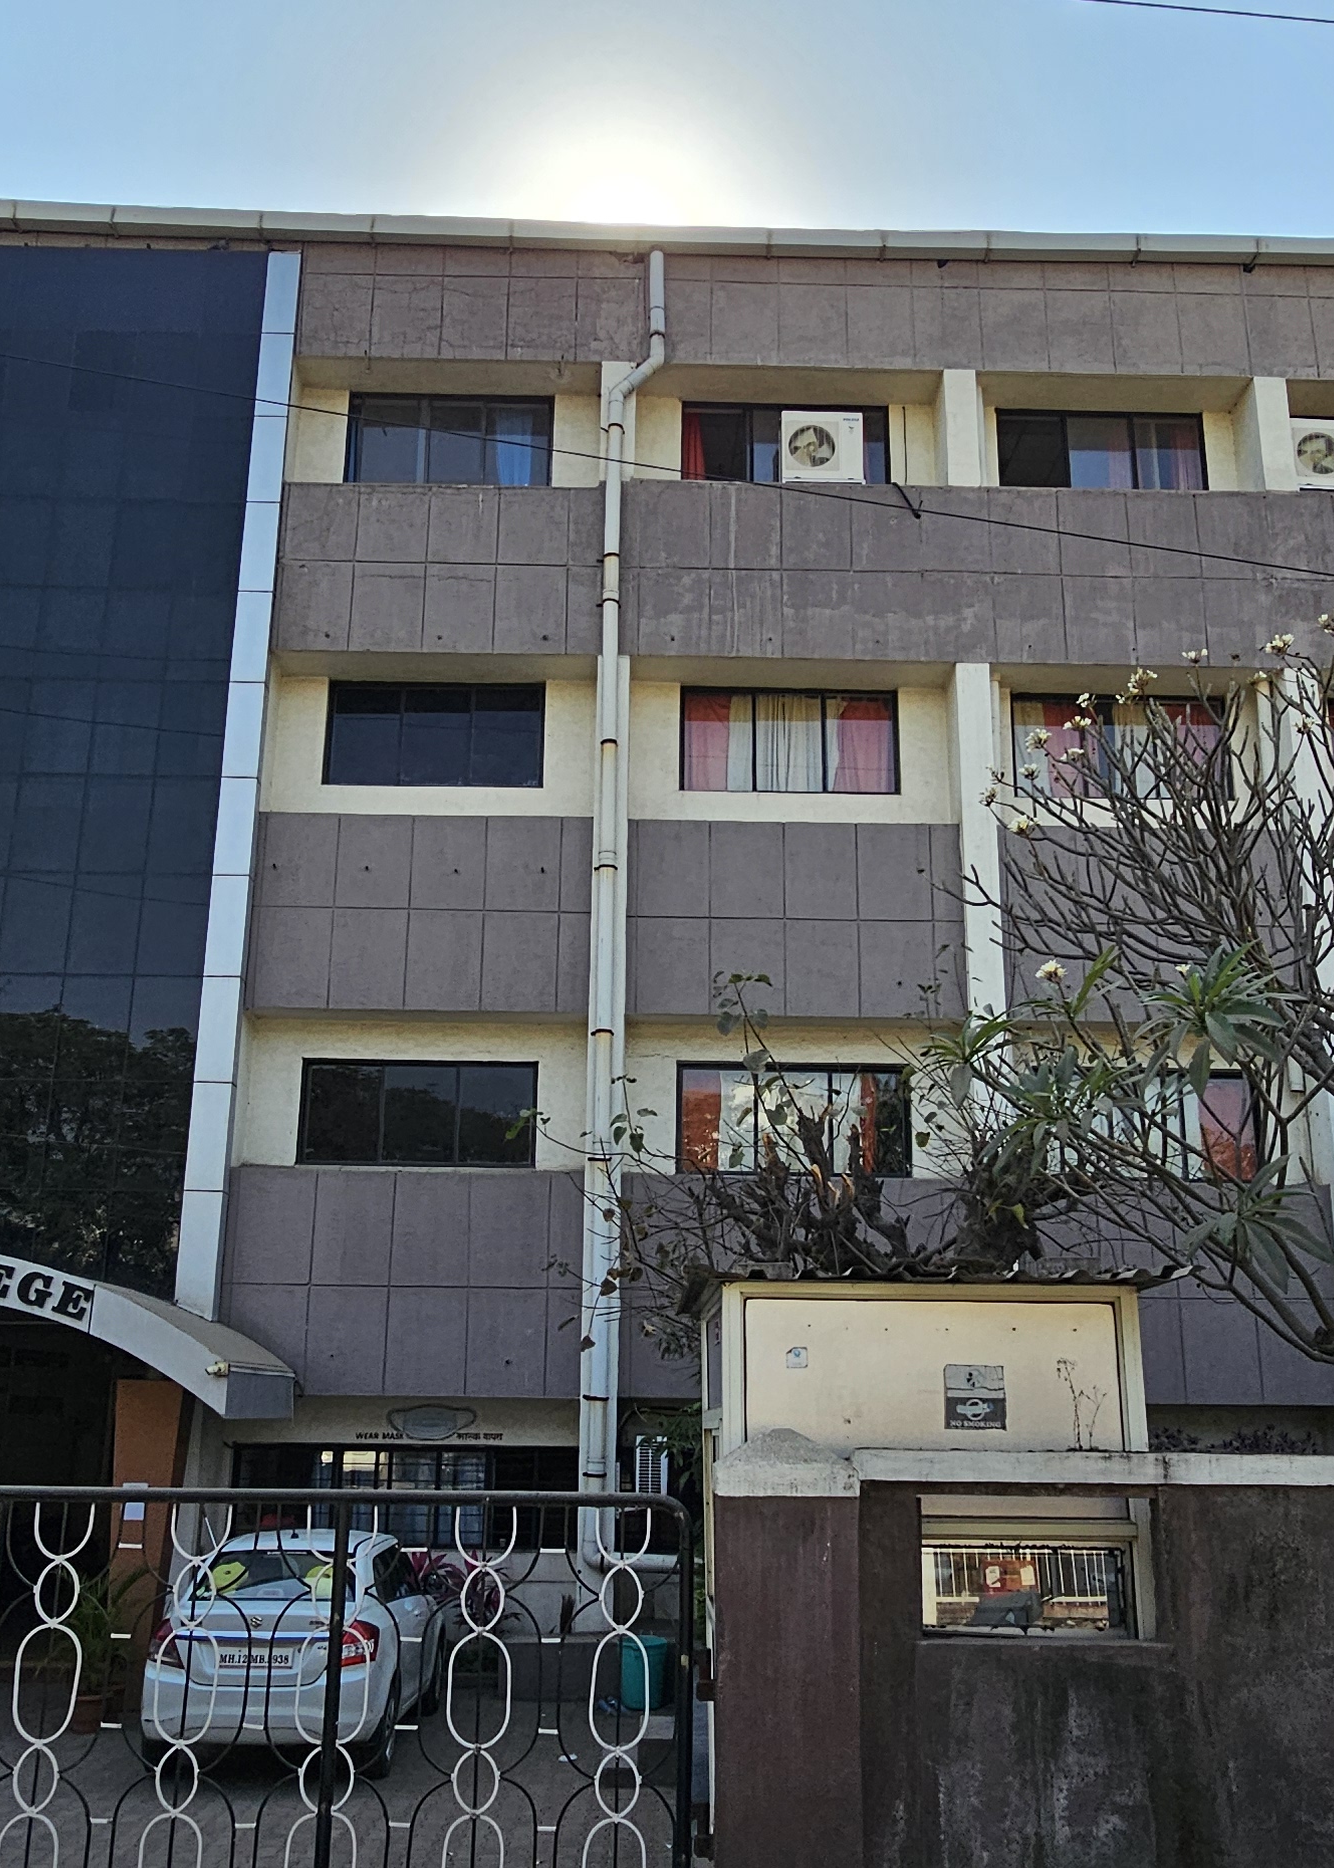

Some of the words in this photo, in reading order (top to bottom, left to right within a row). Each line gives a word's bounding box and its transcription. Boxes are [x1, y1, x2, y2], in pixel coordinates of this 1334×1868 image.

[963, 1420, 1002, 1428] SMOKING
[355, 1432, 379, 1441] WEAR
[382, 1432, 405, 1441] MASK
